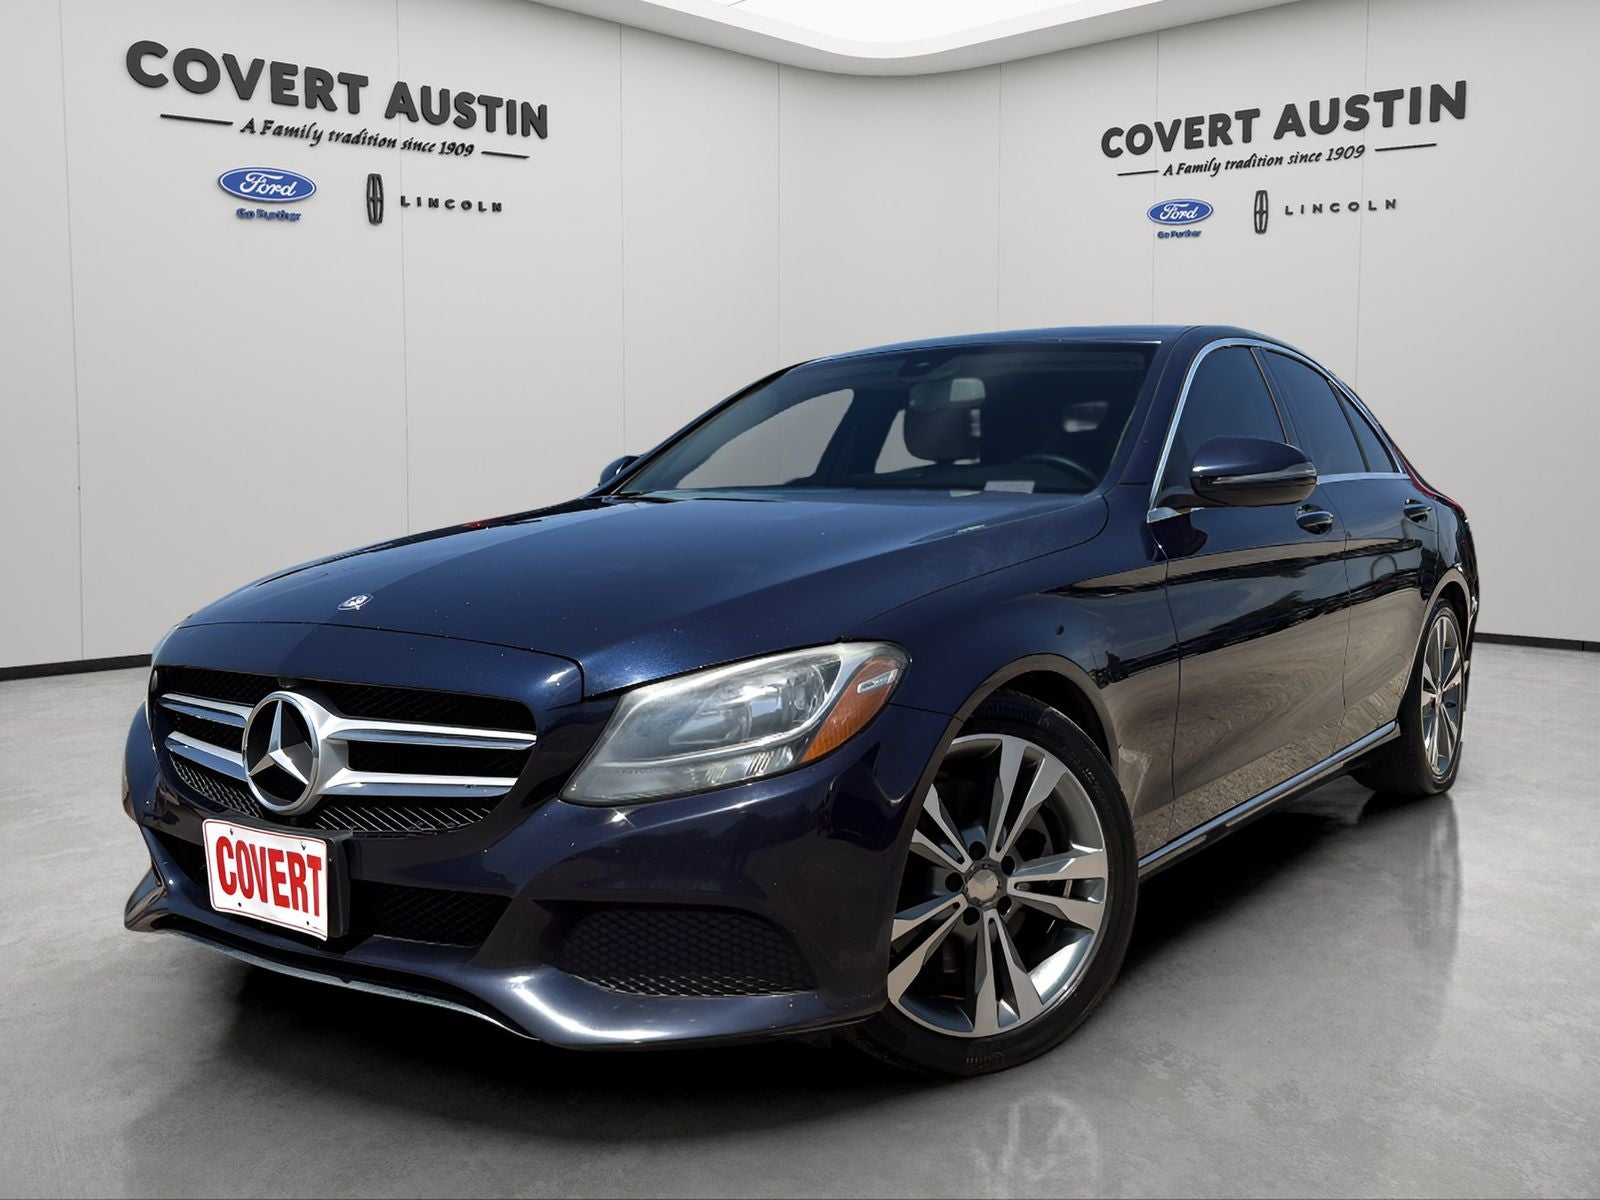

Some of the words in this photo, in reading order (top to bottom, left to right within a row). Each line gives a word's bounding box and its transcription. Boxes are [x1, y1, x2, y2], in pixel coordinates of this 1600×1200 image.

[126, 40, 368, 115] COVERT
[384, 80, 548, 140] AUSTIN
[1100, 108, 1260, 158] COVERT
[1272, 80, 1467, 140] AUSTIN
[240, 117, 257, 135] A
[259, 119, 324, 148] Family
[328, 128, 398, 149] tradition
[400, 136, 437, 153] since
[438, 140, 475, 157] 1909
[1162, 163, 1174, 177] A
[1175, 156, 1221, 178] Family
[1224, 152, 1284, 171] tradition
[1287, 151, 1323, 165] since
[1325, 144, 1366, 162] 1909
[239, 171, 298, 197] Ford
[400, 195, 502, 213] LINCOLN
[1159, 202, 1200, 220] Ford
[1284, 198, 1397, 216] LINCOLN
[215, 836, 322, 917] COVERT
